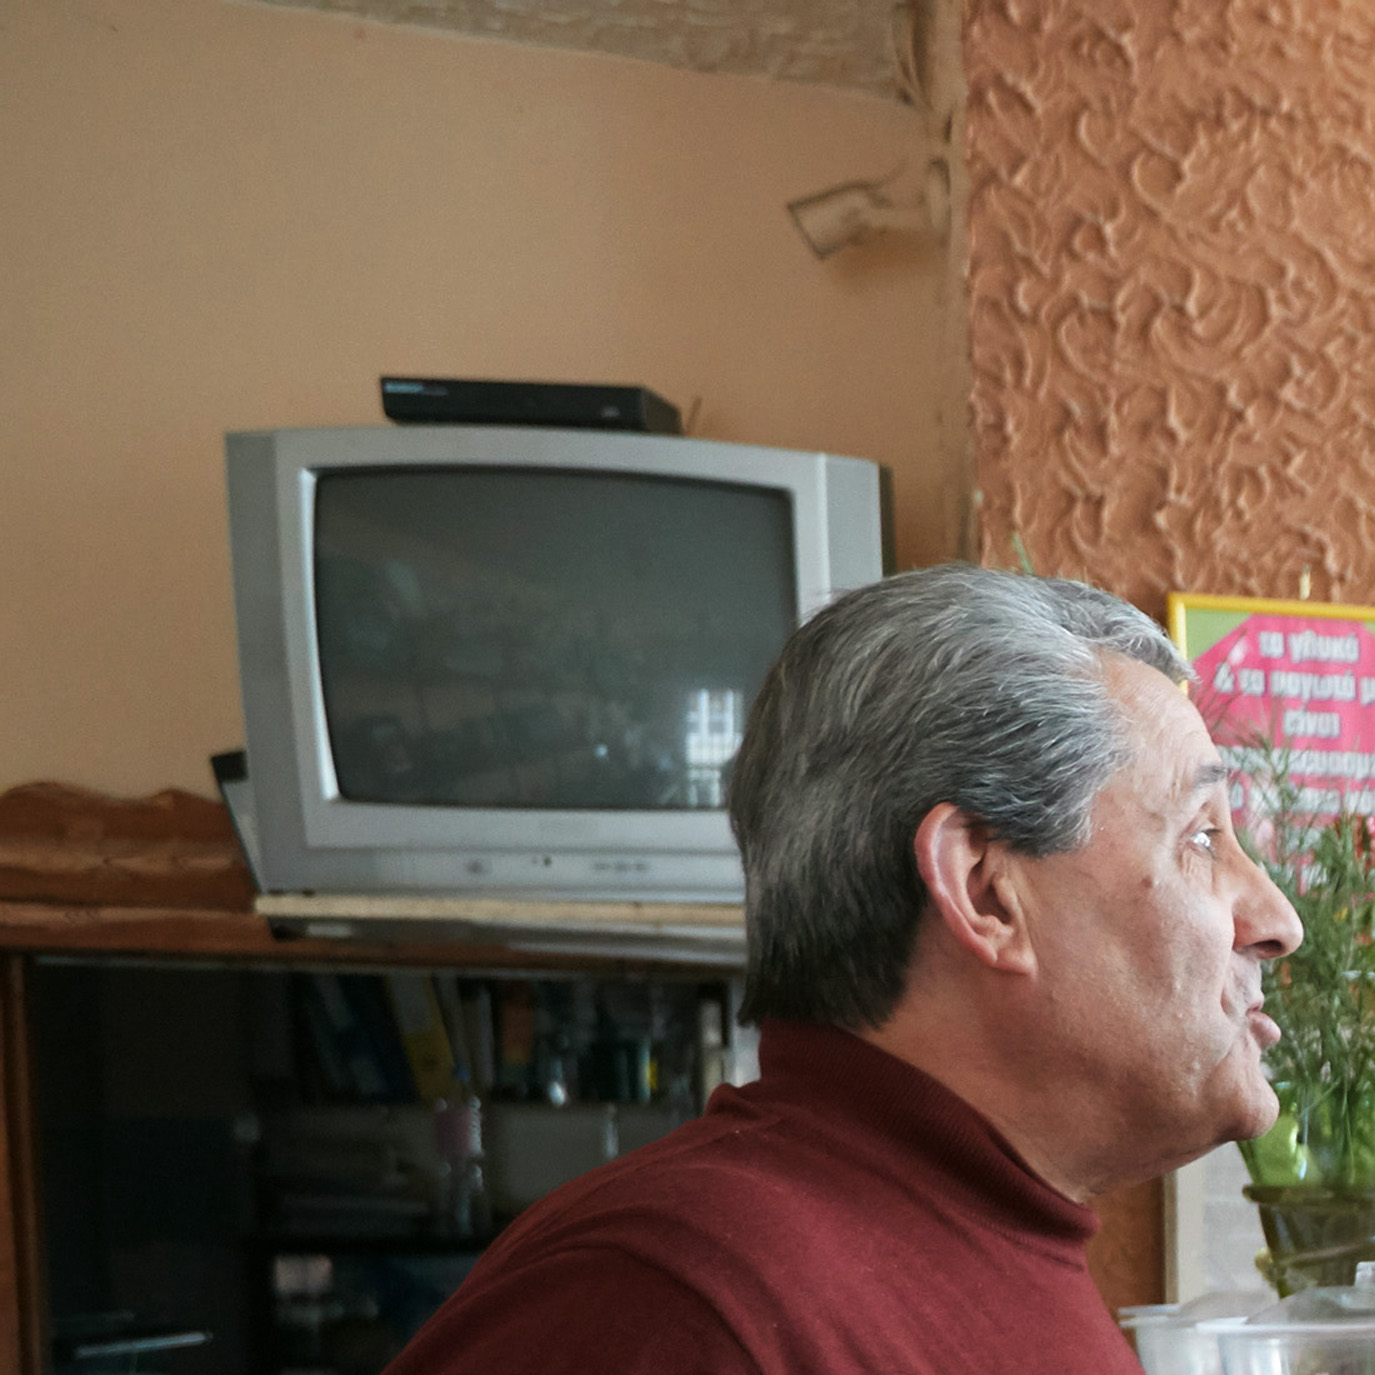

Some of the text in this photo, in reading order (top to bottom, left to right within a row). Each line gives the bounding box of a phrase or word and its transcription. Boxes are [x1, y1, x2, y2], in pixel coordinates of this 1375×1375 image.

[1258, 629, 1361, 664] τα γλυκά
[1213, 662, 1236, 694] &
[1237, 668, 1267, 696] τα
[1270, 668, 1357, 703] παγωτά
[1283, 706, 1342, 738] είναι
